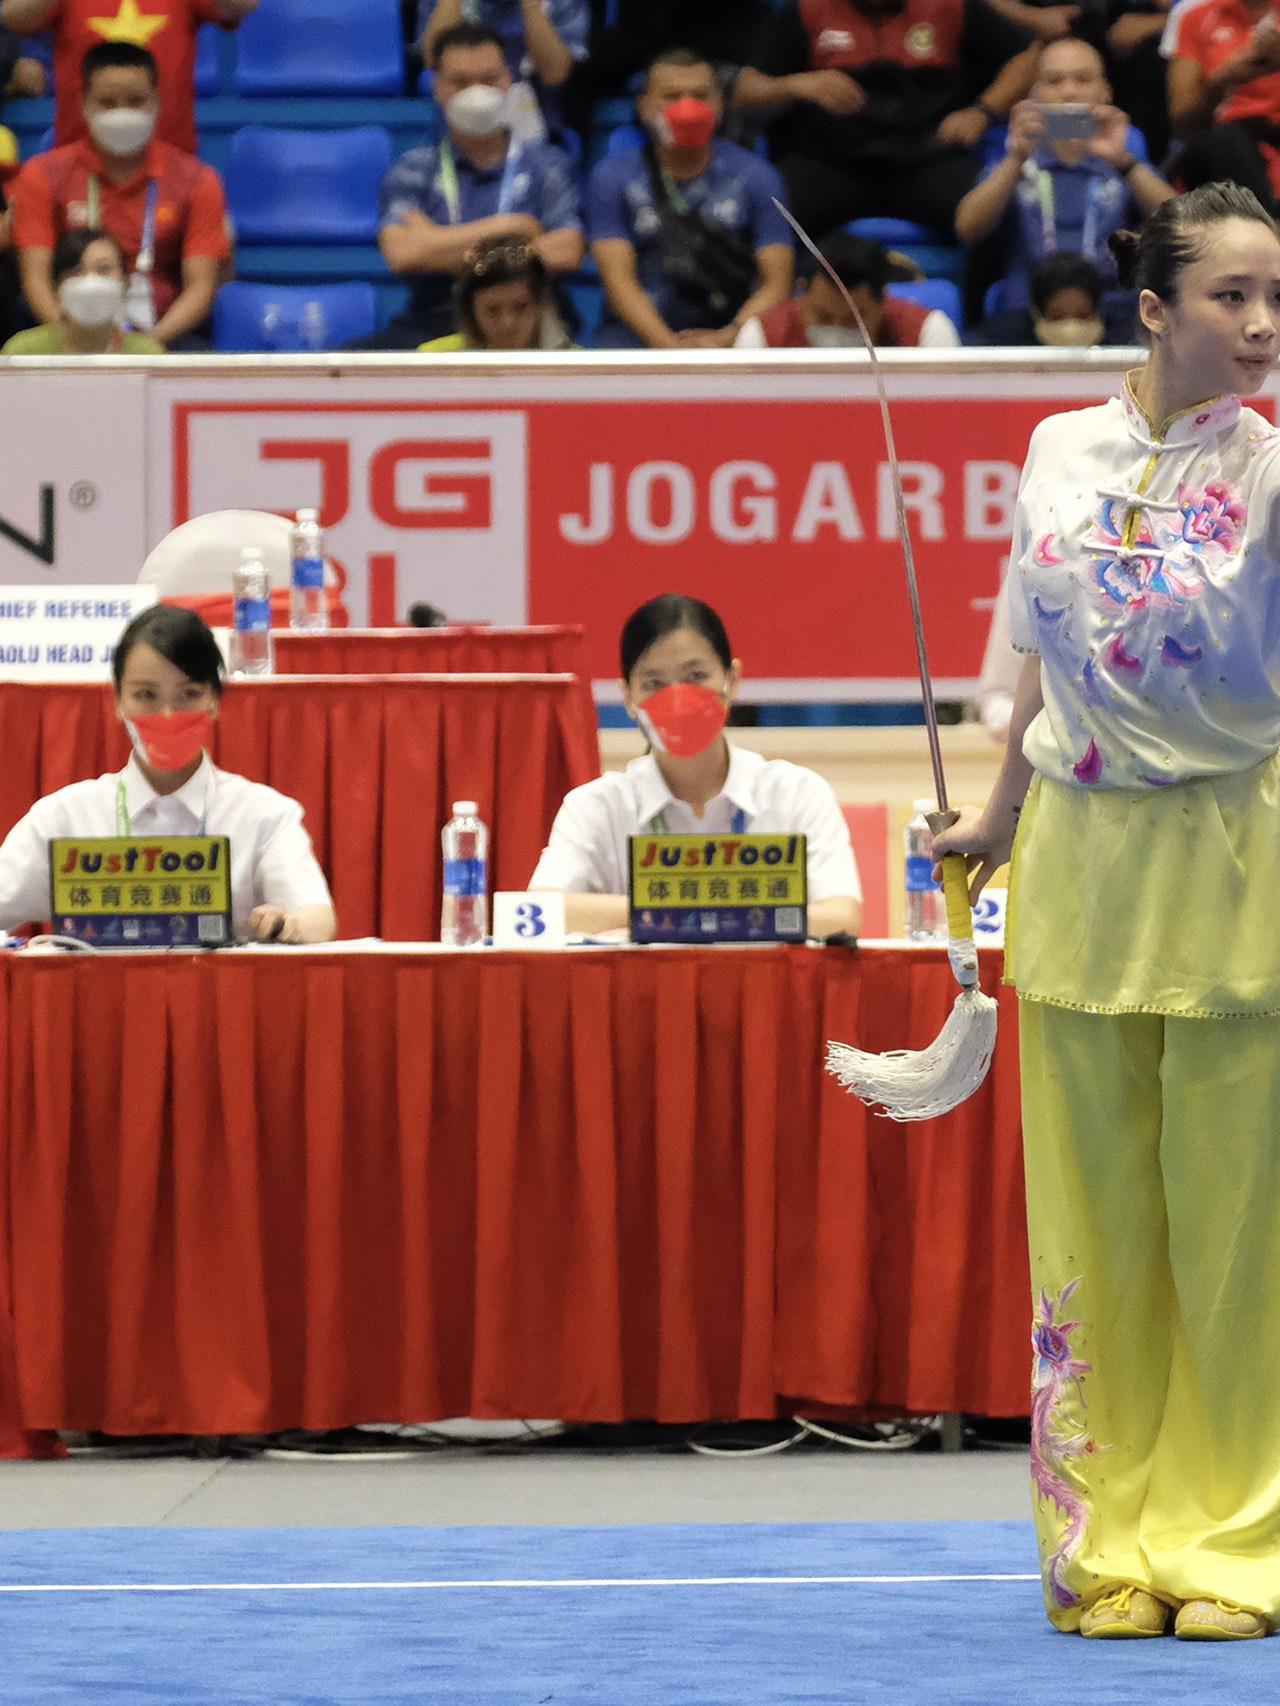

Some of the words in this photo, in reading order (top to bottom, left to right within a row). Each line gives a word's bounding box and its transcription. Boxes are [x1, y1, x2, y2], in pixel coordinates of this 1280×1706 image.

[259, 438, 493, 531] JG
[44, 599, 132, 619] REFEREE
[46, 644, 93, 663] HEAD
[61, 843, 219, 874] JustTool
[640, 835, 798, 868] JustTool
[513, 902, 546, 938] 3
[973, 897, 1001, 934] 2
